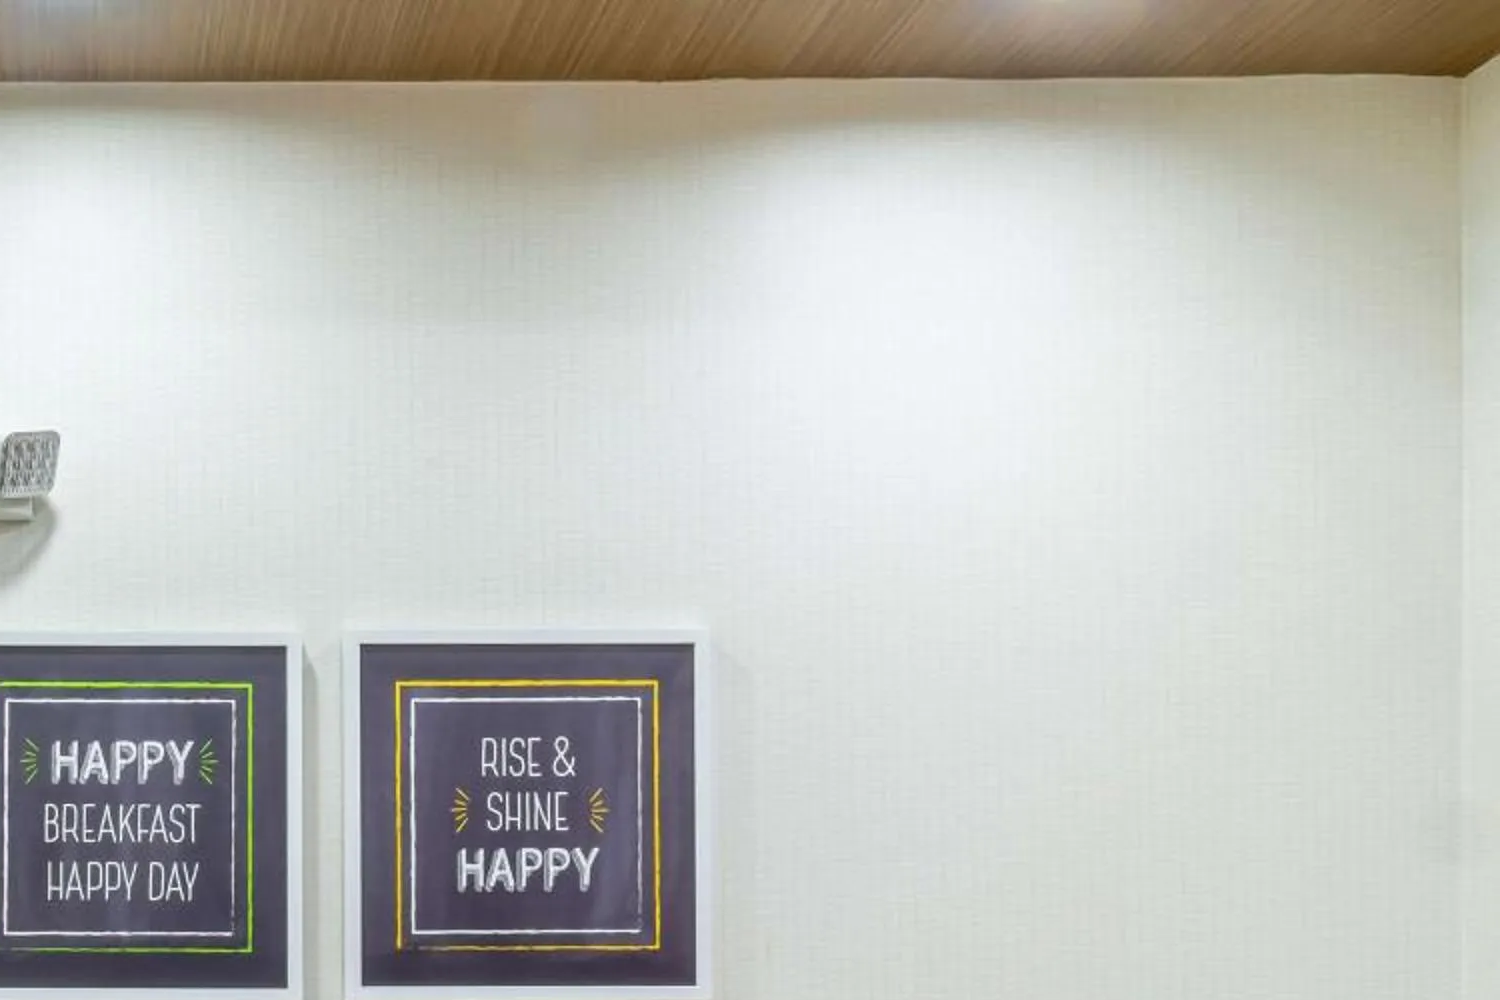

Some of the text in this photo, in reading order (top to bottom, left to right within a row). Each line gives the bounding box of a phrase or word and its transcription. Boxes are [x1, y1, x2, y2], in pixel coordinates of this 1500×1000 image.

[50, 740, 196, 785] HAPPY
[481, 735, 577, 778] RISE &
[43, 803, 202, 844] BREAKFAST
[486, 791, 570, 832] SHINE
[46, 861, 200, 902] HAPPY DAY
[456, 847, 600, 893] HAPPY
